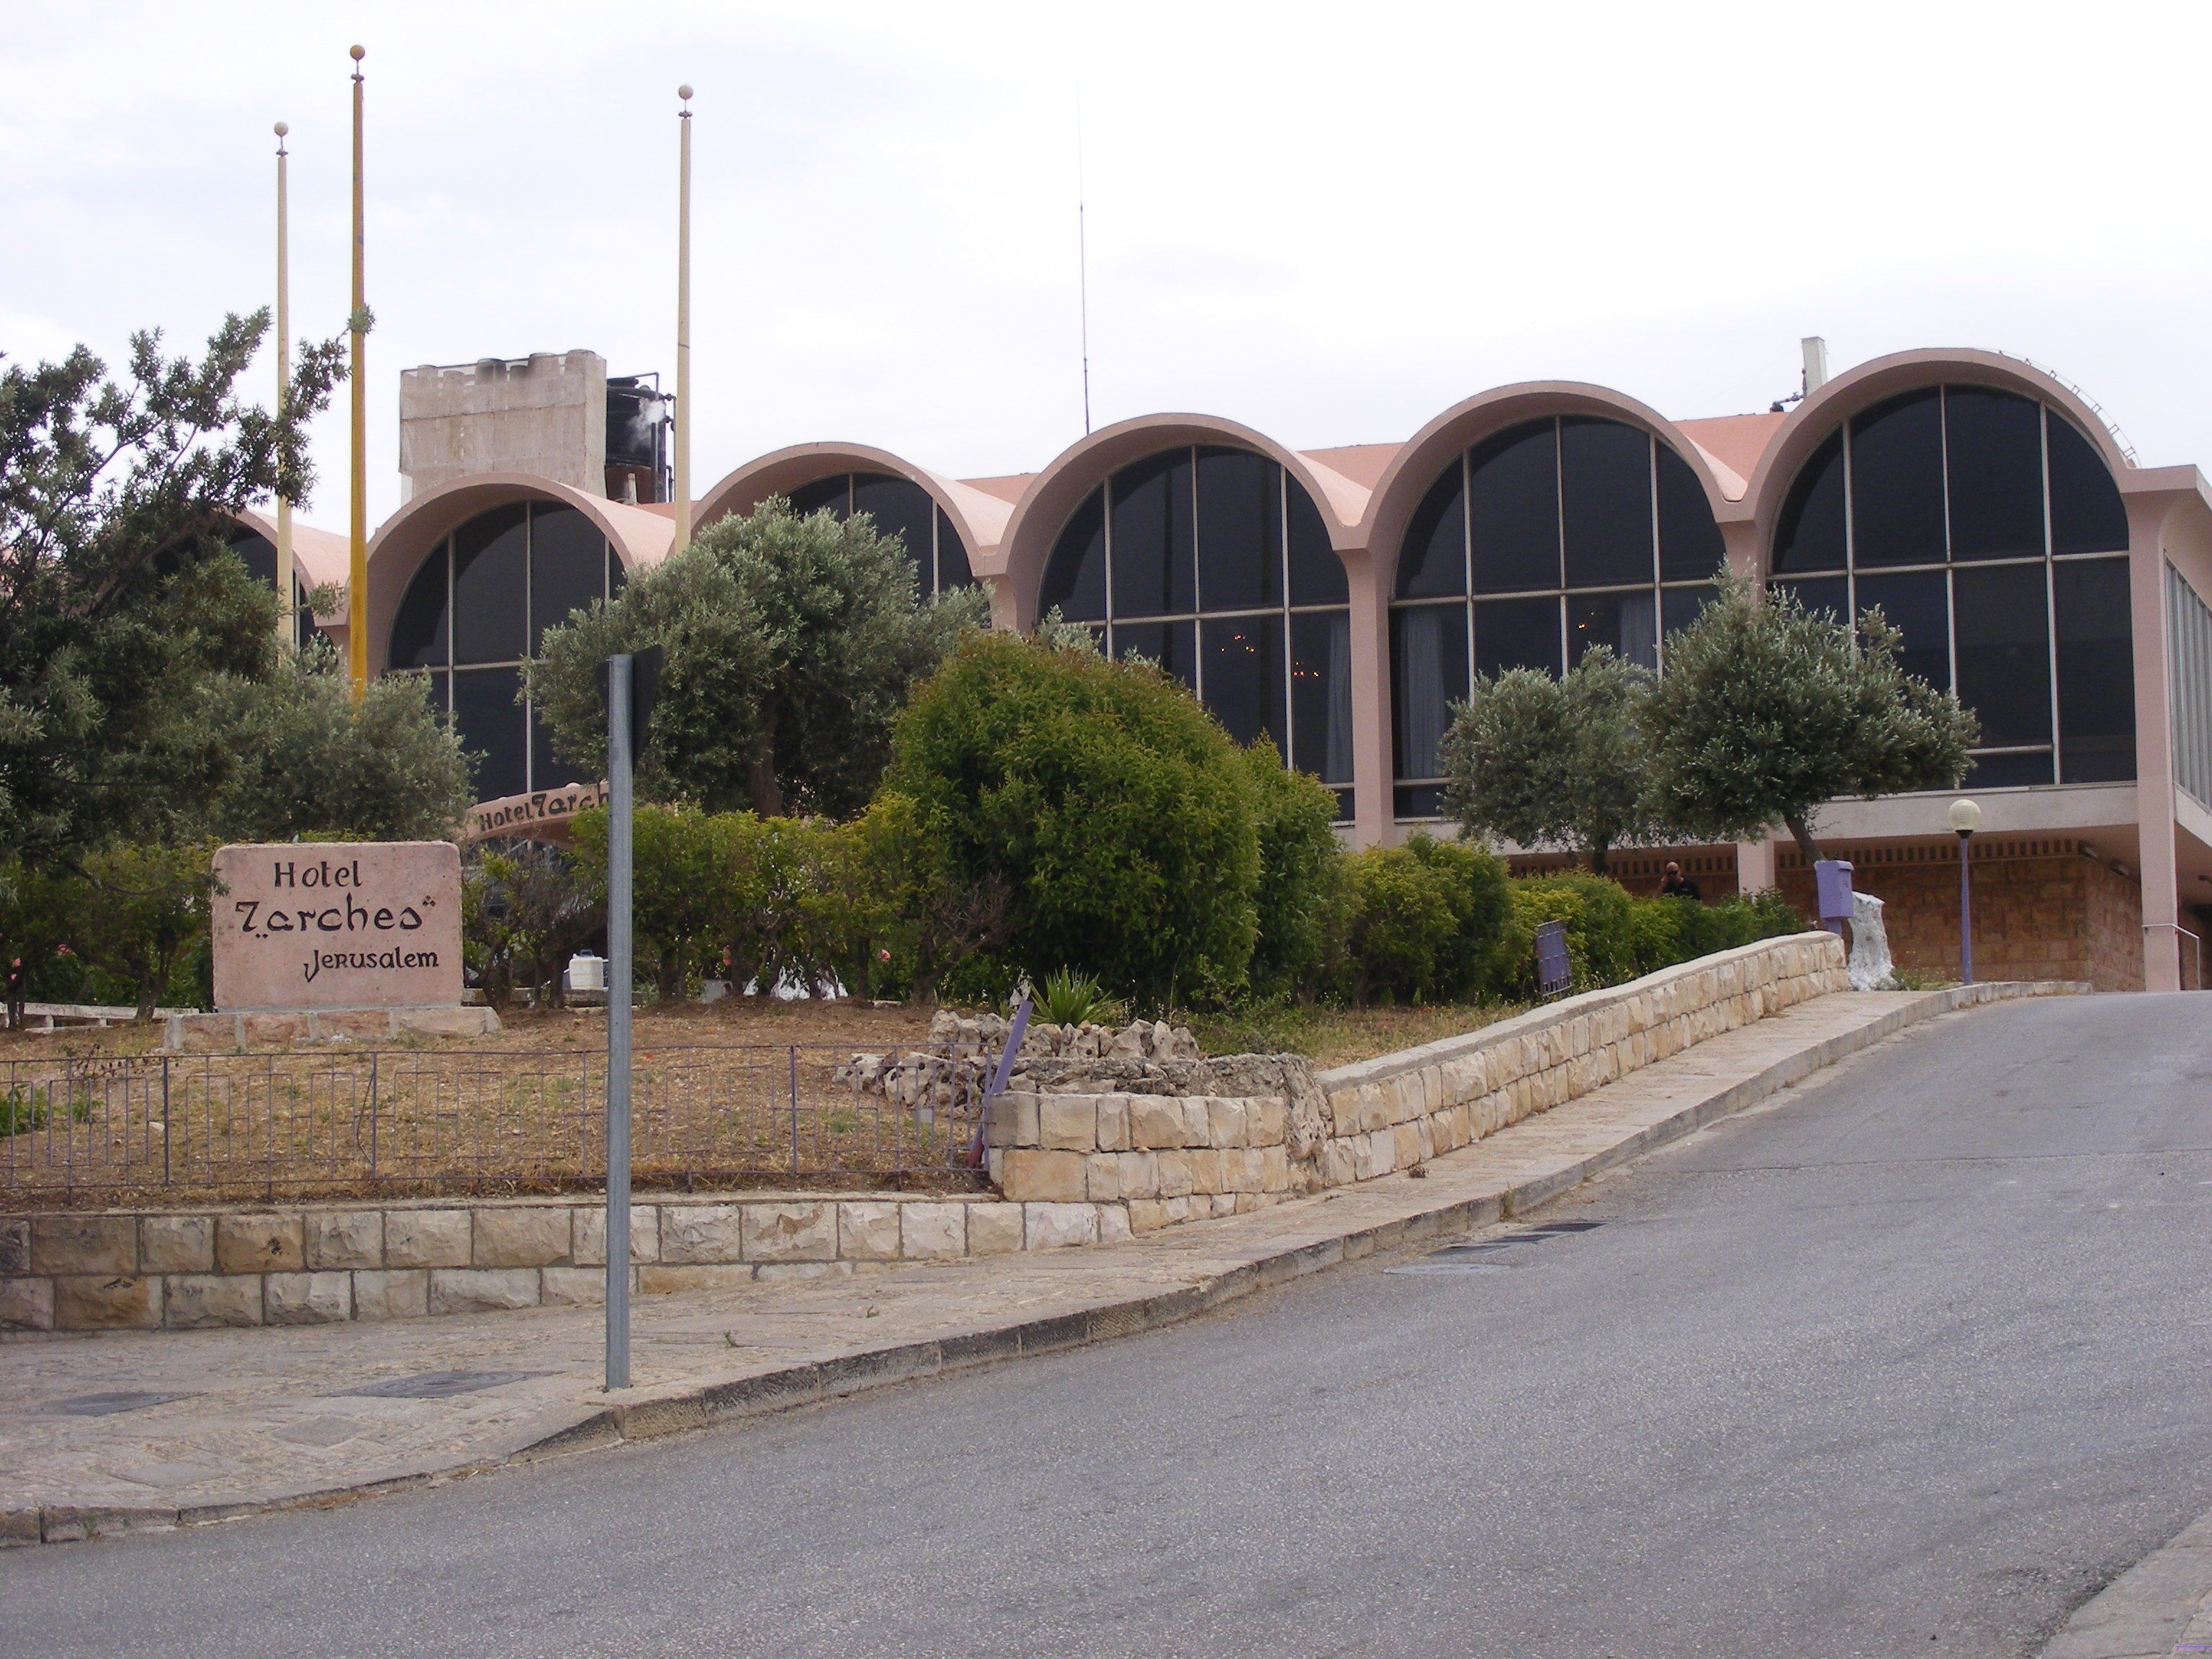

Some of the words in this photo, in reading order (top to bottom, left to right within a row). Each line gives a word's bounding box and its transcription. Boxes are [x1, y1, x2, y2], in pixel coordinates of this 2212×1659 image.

[479, 801, 533, 832] Hotel
[274, 860, 362, 888] Hotel
[235, 892, 436, 939] 7arches
[304, 945, 439, 983] Jerusalem
